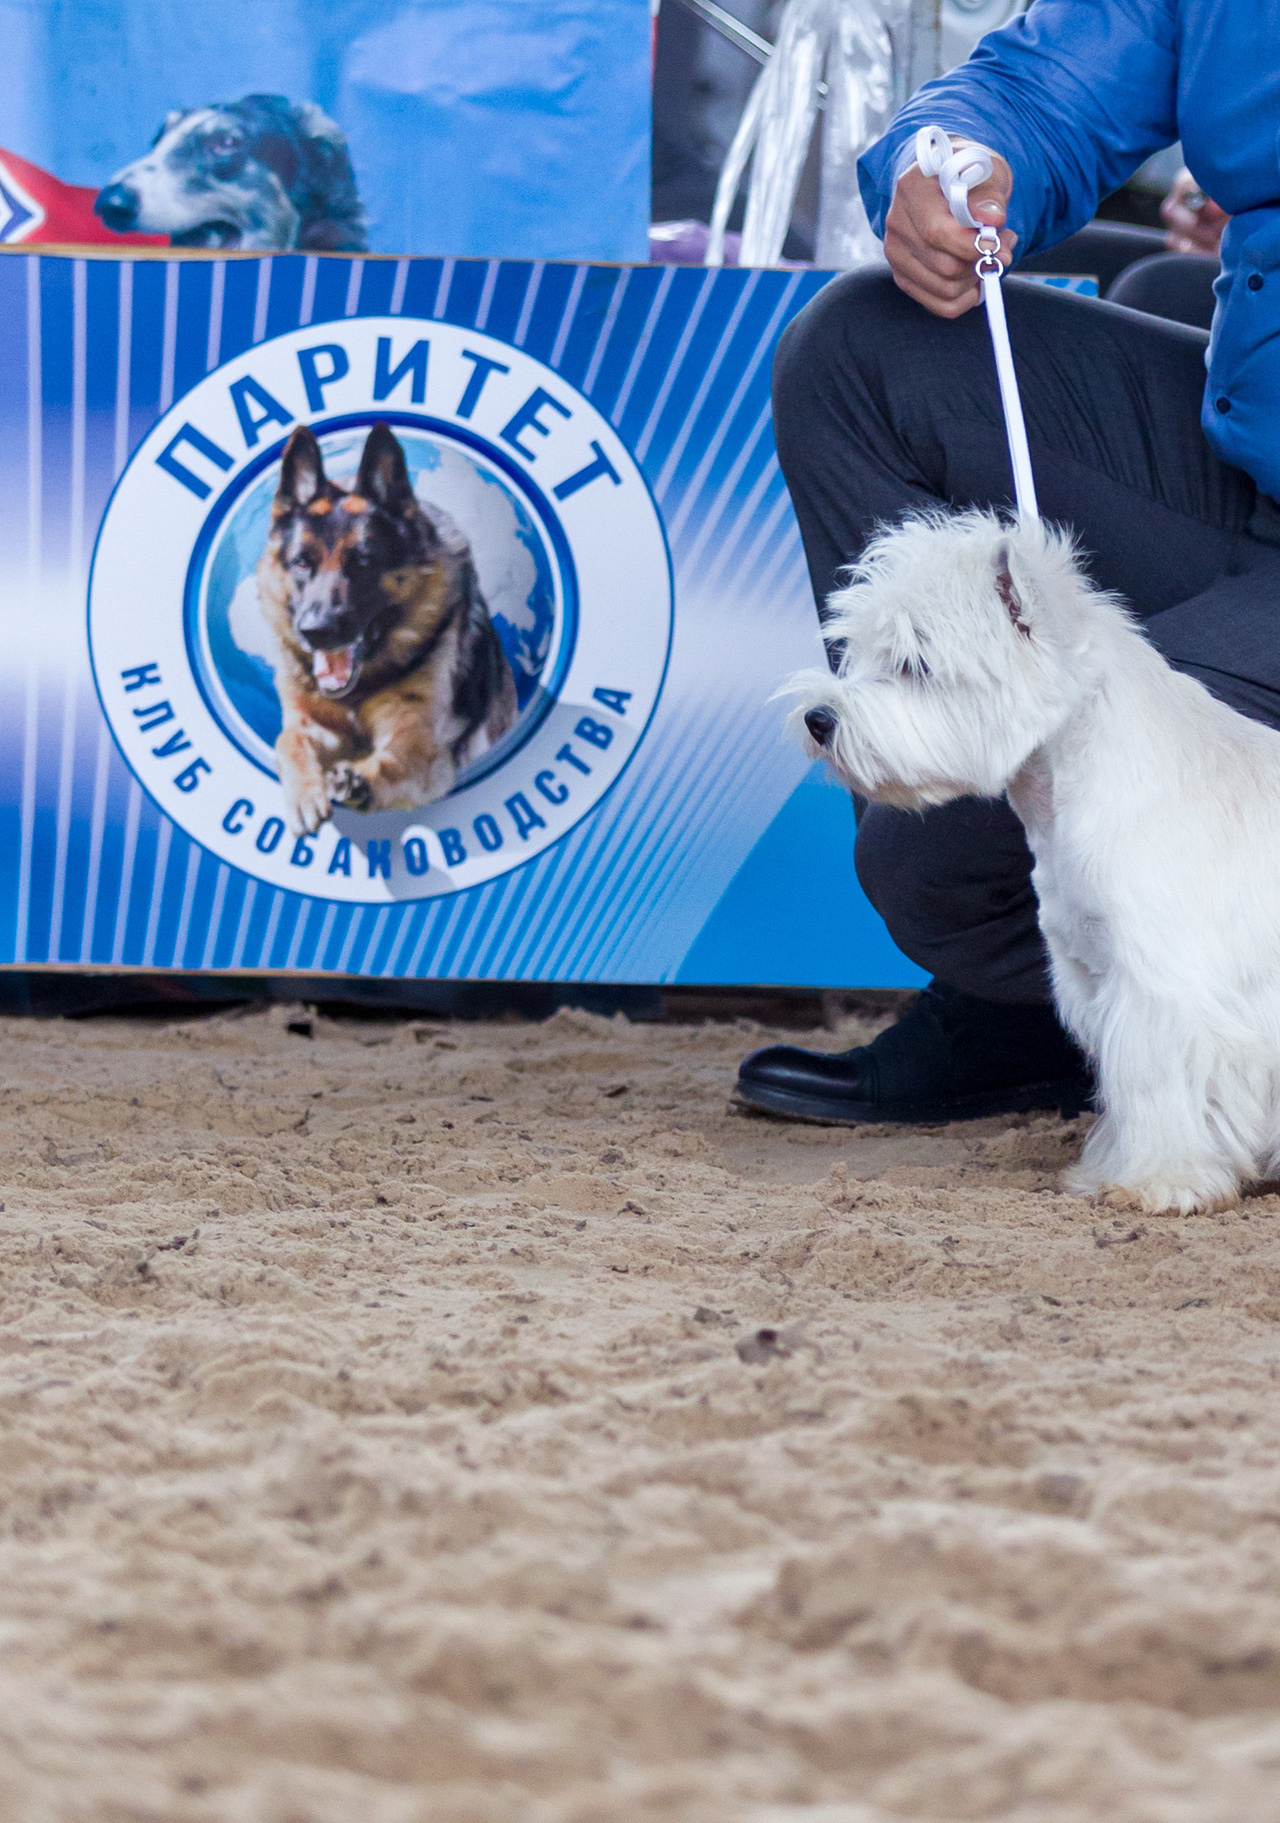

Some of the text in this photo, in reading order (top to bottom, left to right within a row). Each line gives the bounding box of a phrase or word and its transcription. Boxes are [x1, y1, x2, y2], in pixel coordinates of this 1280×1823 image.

[154, 335, 623, 501] ПАРИТЕТ
[121, 660, 633, 880] КЛУБ СОБАКОВОДСТВА
